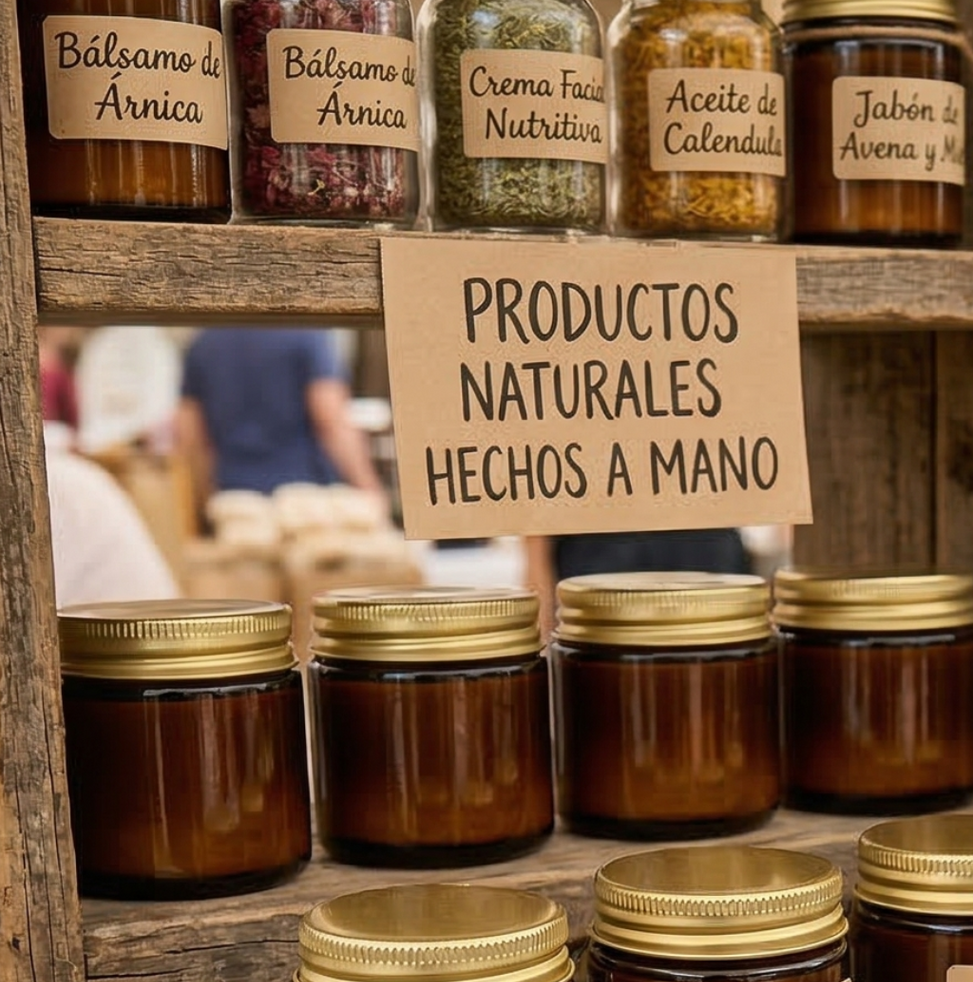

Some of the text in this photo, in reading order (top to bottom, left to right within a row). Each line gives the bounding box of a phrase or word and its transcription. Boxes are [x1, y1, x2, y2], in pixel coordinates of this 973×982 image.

[54, 30, 223, 80] Bálsamo de
[281, 45, 398, 84] Bálsamo
[94, 71, 205, 126] Árnica
[469, 65, 605, 104] Crema Facia
[666, 79, 778, 117] Aceite de
[316, 81, 408, 130] Árnica
[485, 108, 603, 144] Nutritiva
[853, 89, 935, 128] Jabón
[663, 122, 783, 158] Calendula
[839, 131, 918, 161] Avena
[925, 143, 936, 172] y
[463, 276, 739, 344] PRODUCTOS
[460, 357, 722, 422] NATURALES
[426, 435, 778, 506] HECHOS A MANO
